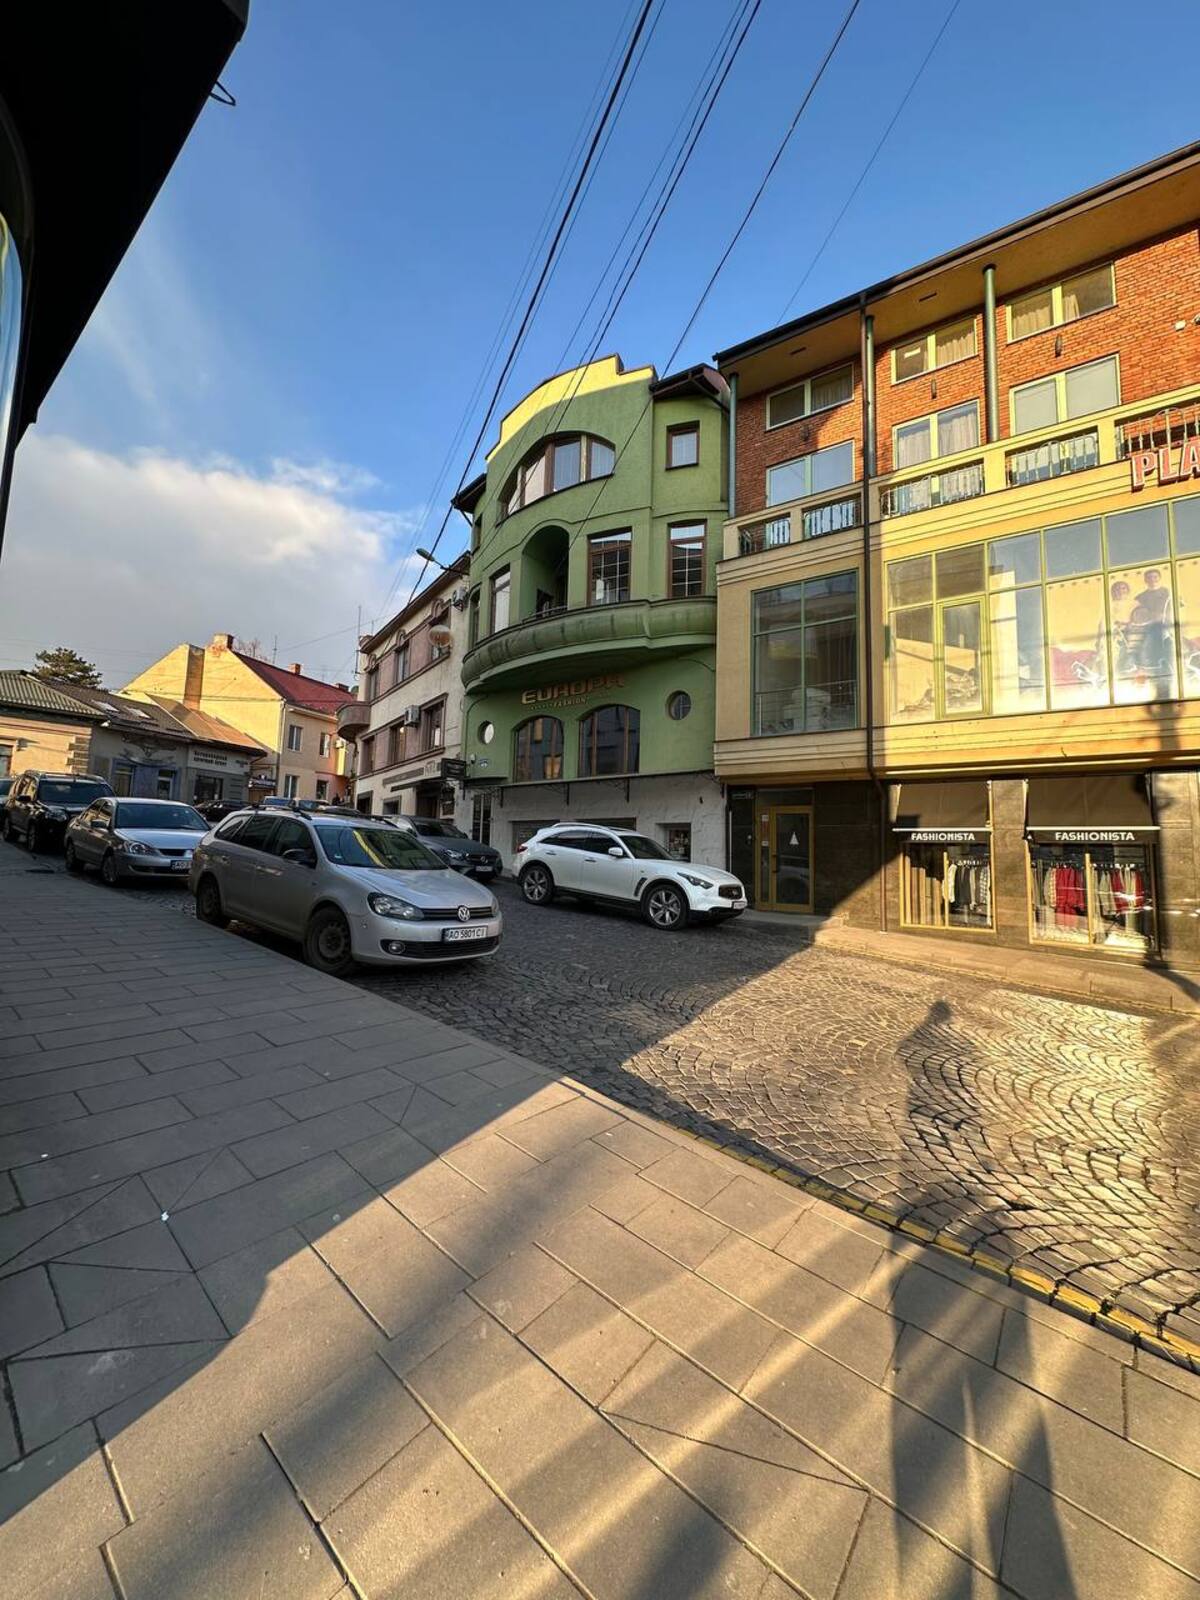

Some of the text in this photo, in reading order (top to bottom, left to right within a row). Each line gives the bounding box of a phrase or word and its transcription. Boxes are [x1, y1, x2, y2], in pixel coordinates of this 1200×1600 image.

[521, 674, 625, 704] EUROPA
[911, 832, 975, 841] FASHIONISTA
[1055, 831, 1135, 841] FASHIONISTA
[461, 929, 475, 938] 5801
